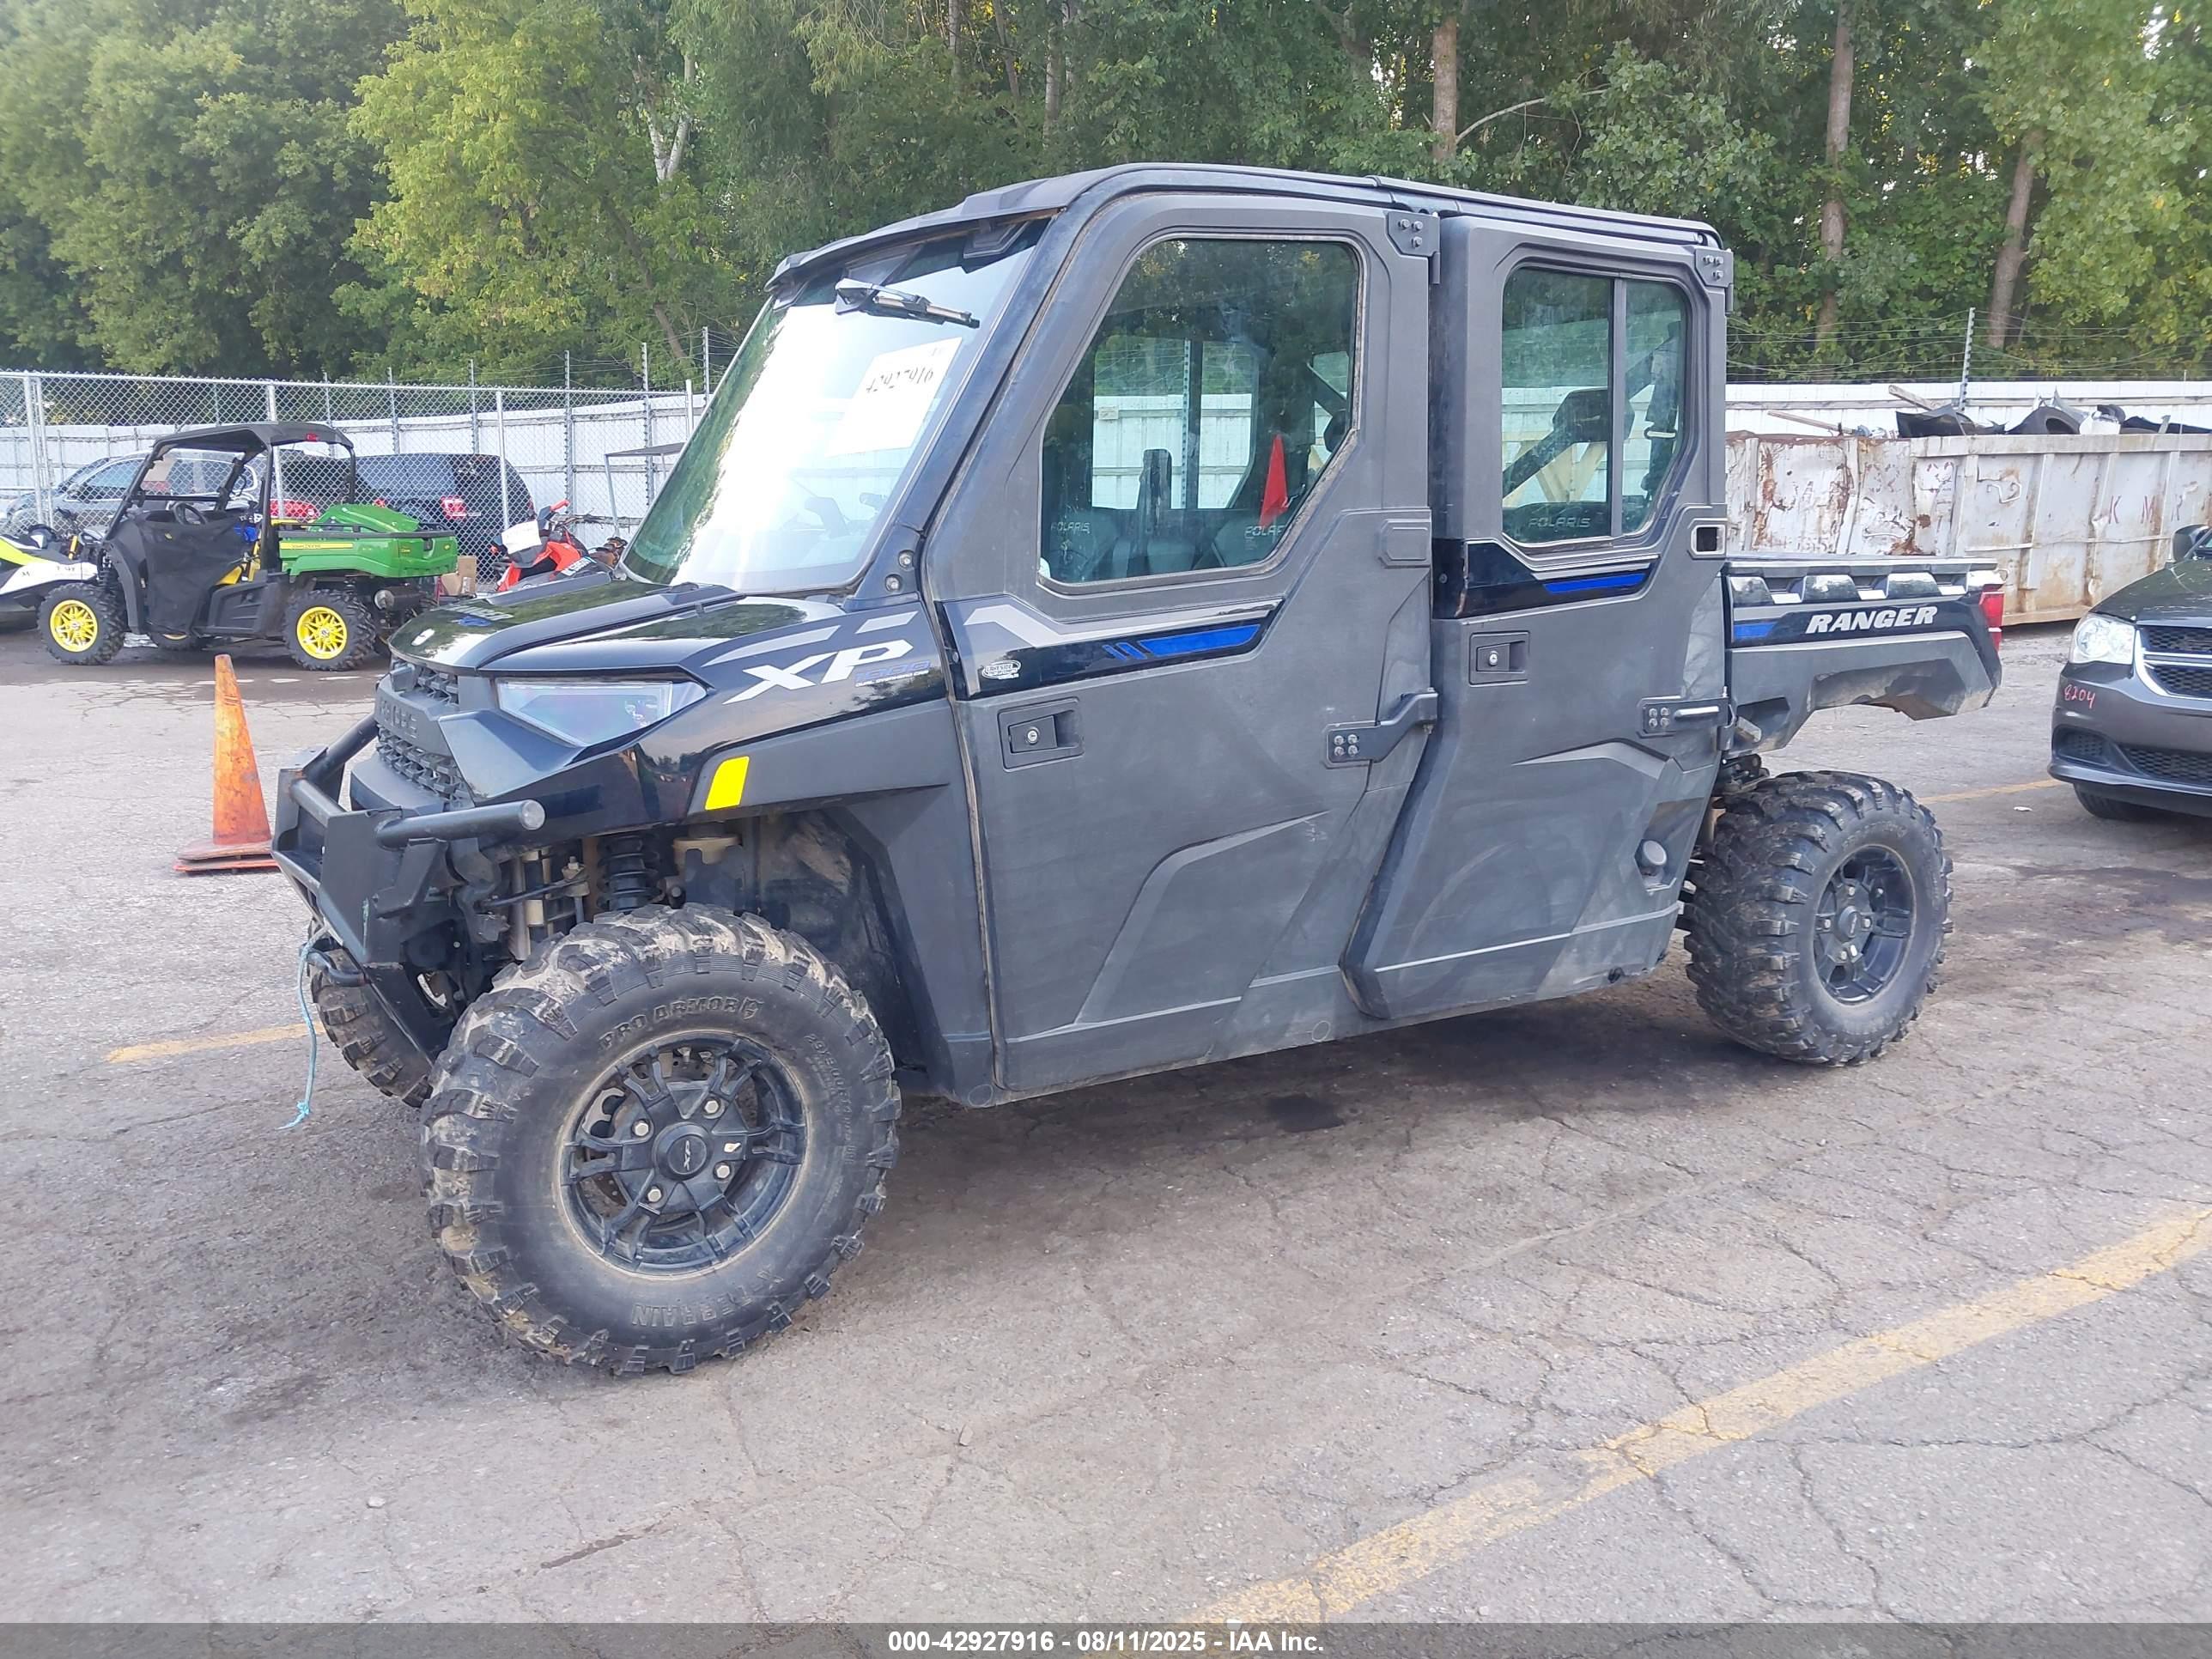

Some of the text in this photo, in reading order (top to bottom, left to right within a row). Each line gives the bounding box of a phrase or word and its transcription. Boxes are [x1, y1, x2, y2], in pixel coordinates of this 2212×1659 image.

[1528, 516, 1591, 529] POLARIS
[2108, 495, 2122, 525] K
[1050, 521, 1091, 532] POLARIS
[1805, 605, 1938, 635] RANGER
[722, 639, 914, 705] XP
[2064, 684, 2096, 709] 8204
[599, 996, 739, 1049] PRO ARMOR
